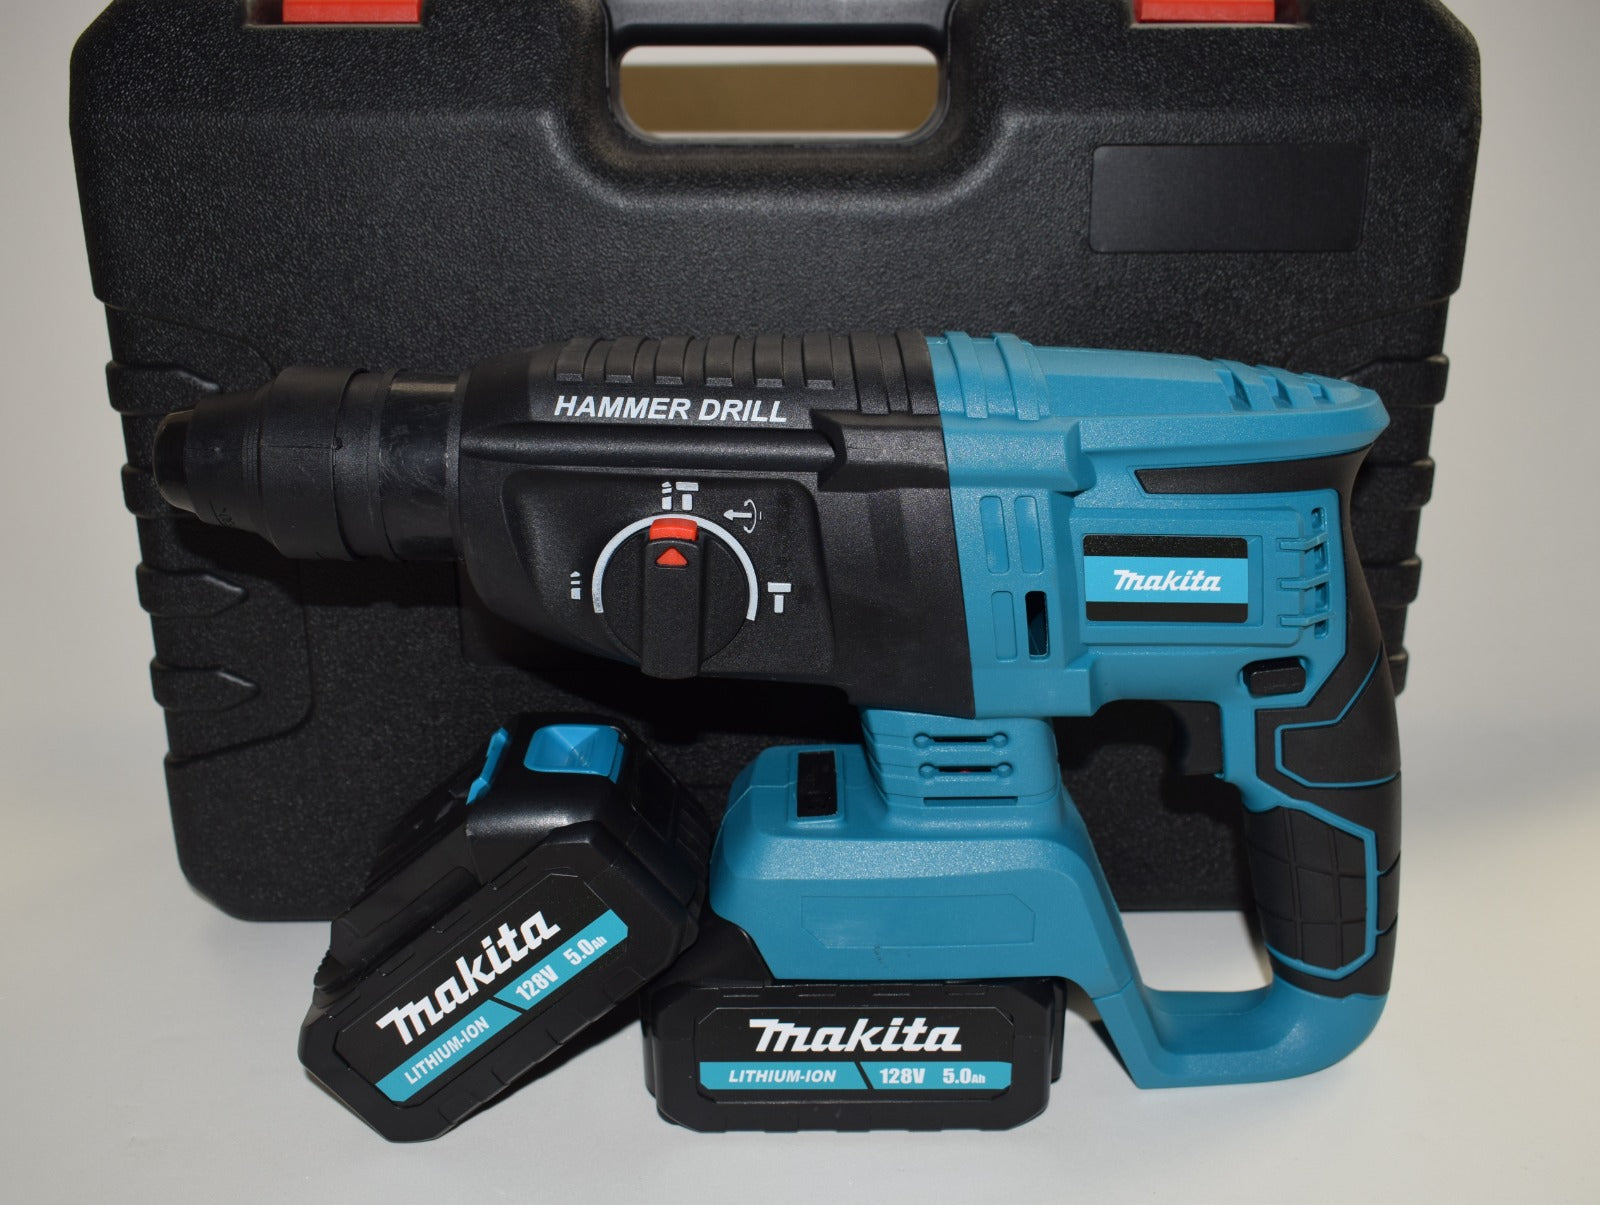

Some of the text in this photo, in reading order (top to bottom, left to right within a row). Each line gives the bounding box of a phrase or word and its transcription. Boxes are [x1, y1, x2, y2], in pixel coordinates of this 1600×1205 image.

[553, 395, 787, 423] HAMMER DRILL
[404, 934, 608, 1085] LITHIUM-ION 128V 5.0Ah
[728, 1067, 986, 1084] LITHIUM-ION 128V 5.0Ah
